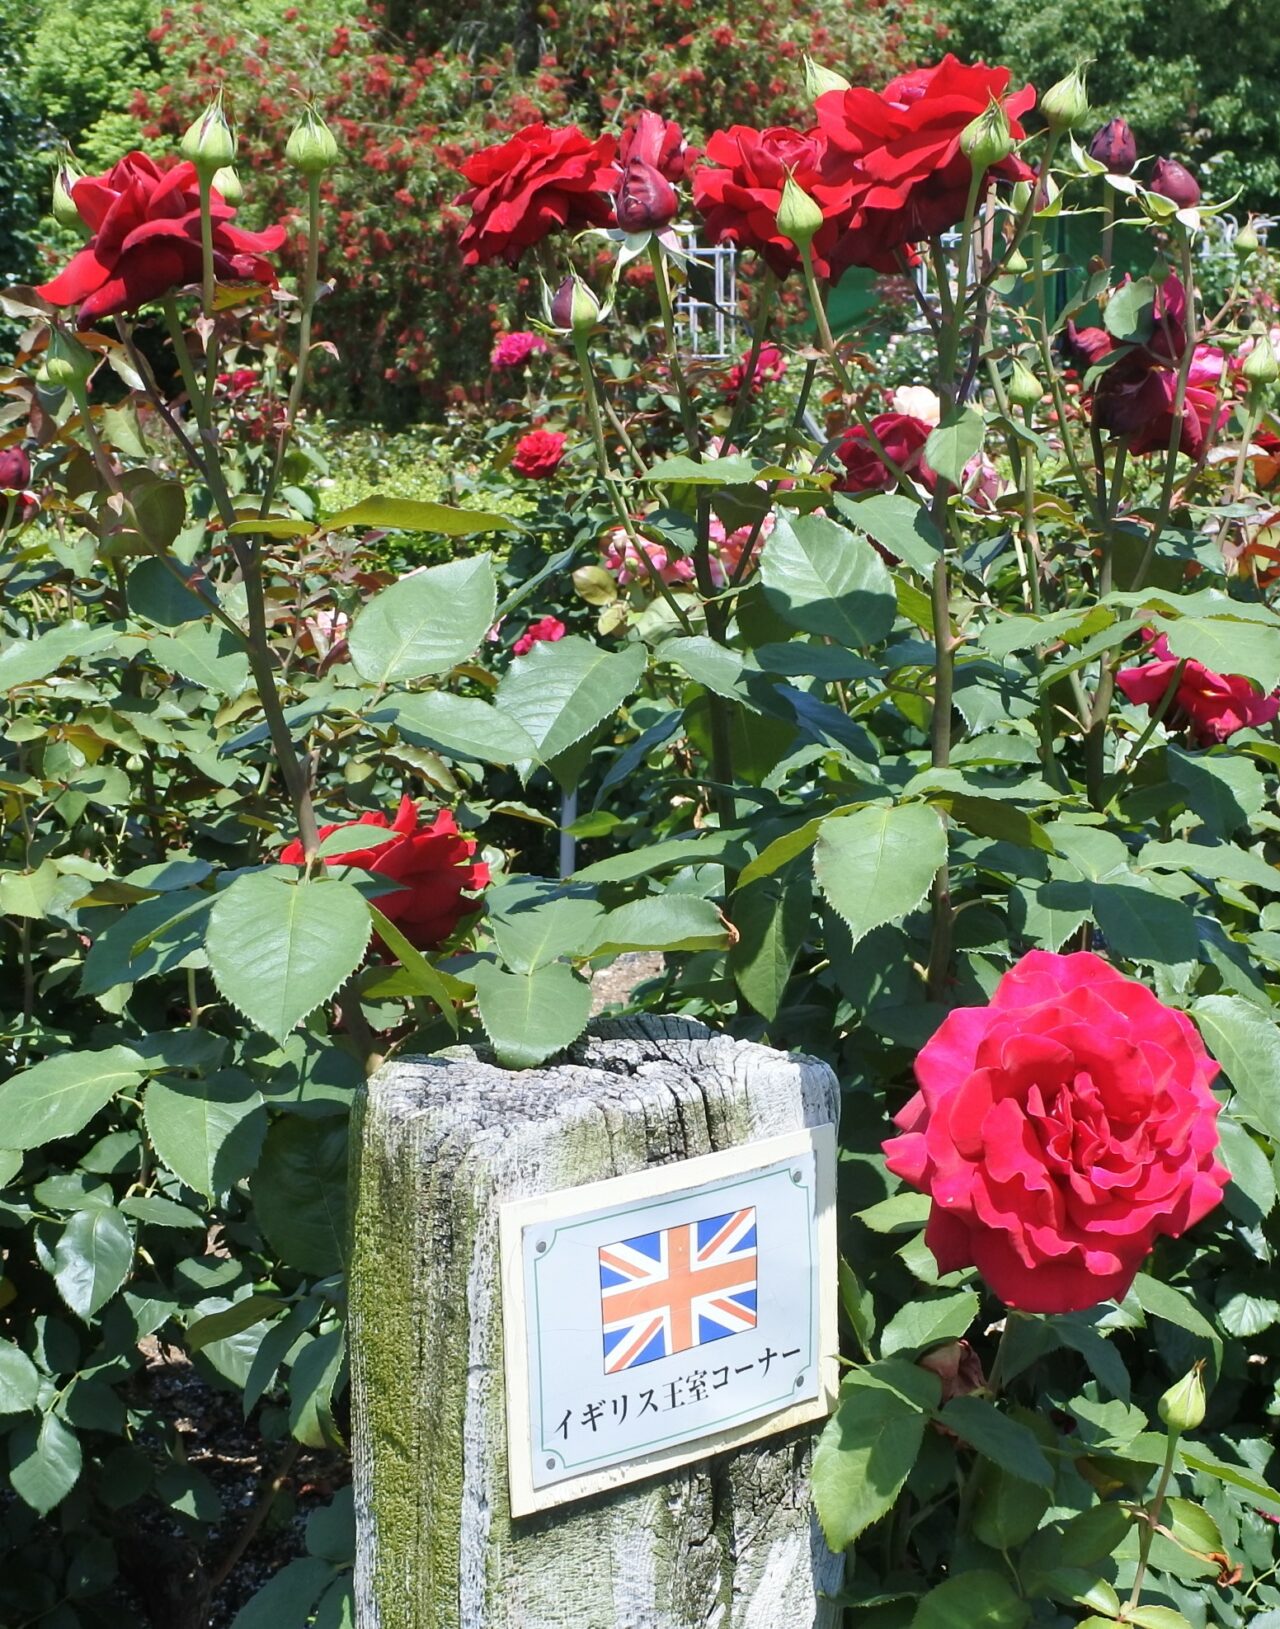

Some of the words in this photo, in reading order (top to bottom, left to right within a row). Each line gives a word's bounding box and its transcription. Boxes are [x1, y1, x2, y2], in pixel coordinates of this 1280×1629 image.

[555, 1347, 801, 1439] イギリス王室コーナー
